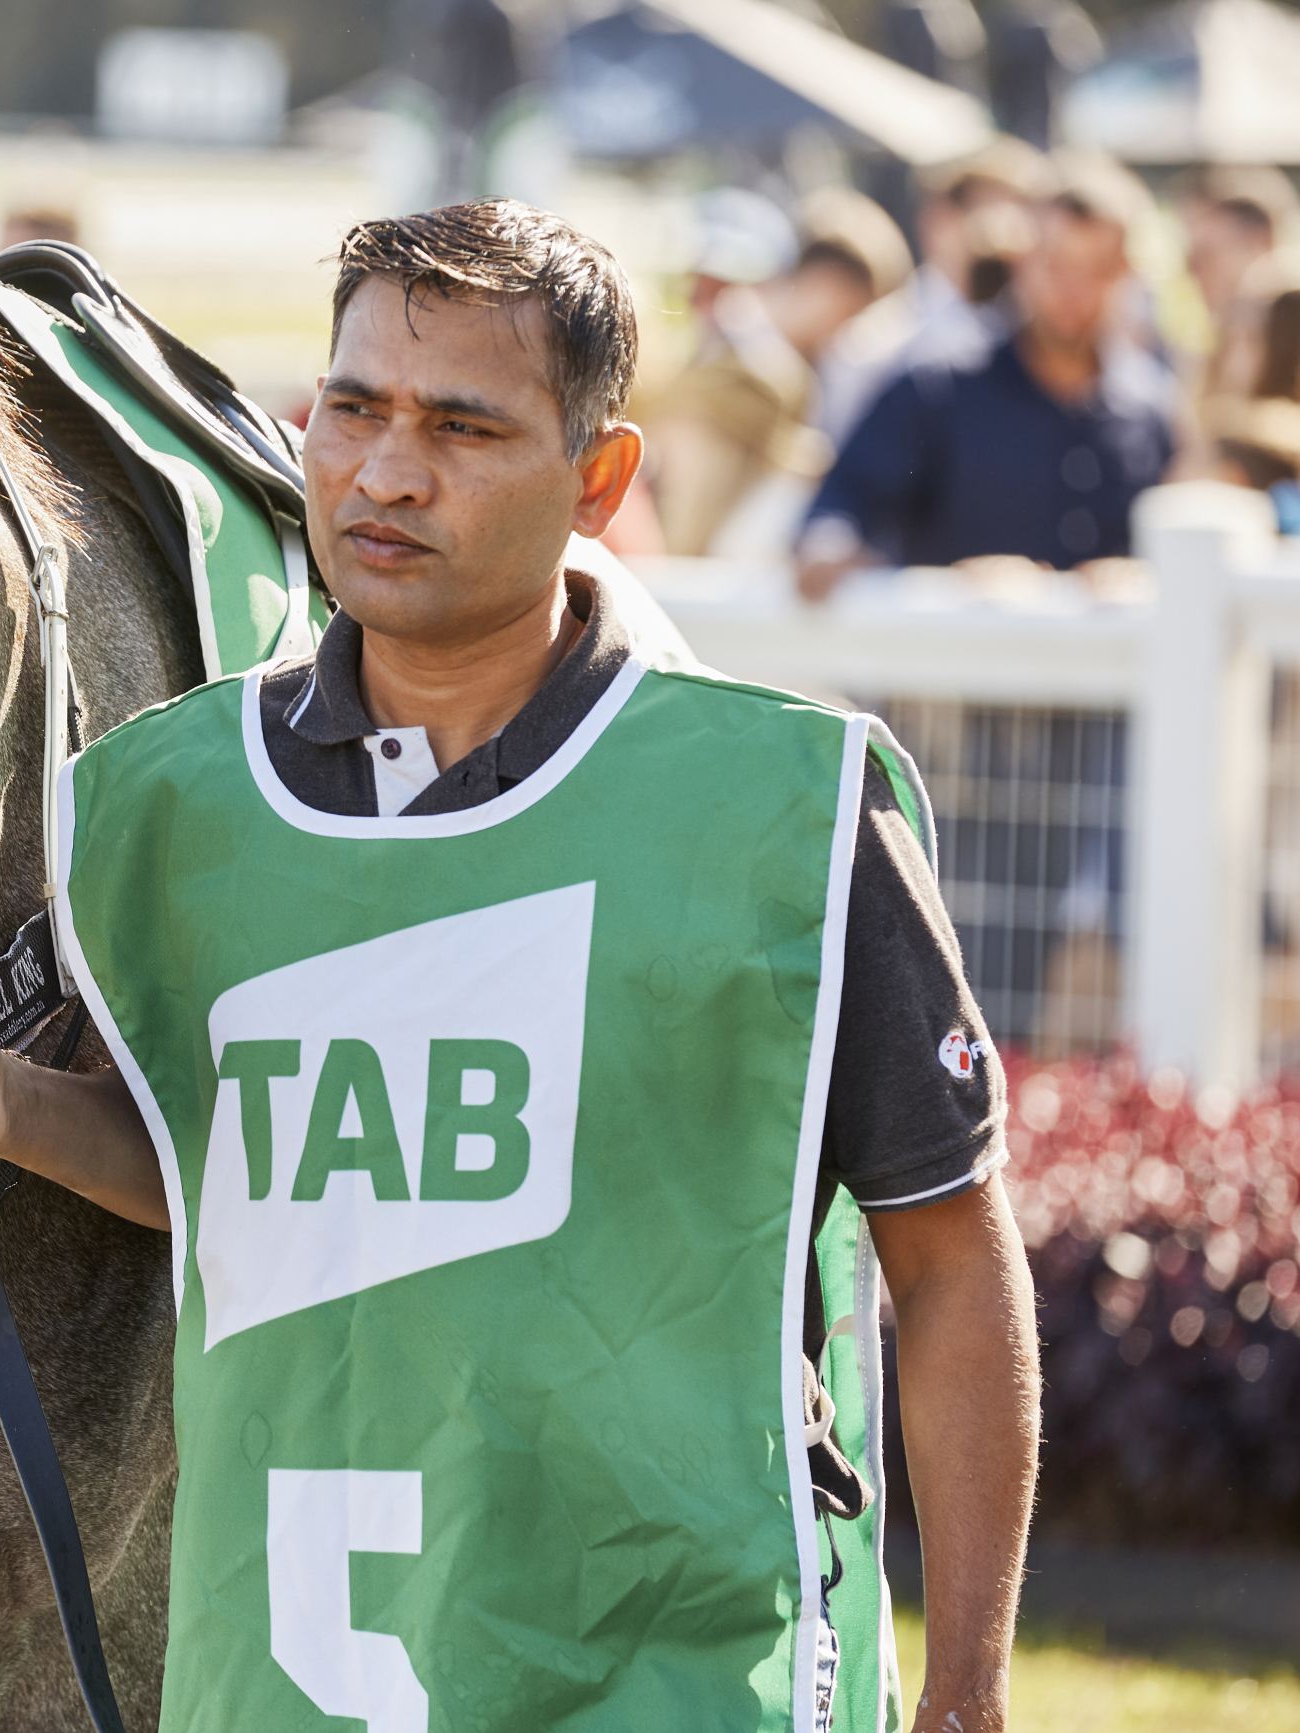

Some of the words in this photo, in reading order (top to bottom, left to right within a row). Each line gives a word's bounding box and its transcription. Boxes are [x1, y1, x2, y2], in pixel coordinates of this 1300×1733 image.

[10, 946, 45, 1005] KING
[218, 1038, 531, 1202] TAB
[266, 1468, 429, 1733] 5
